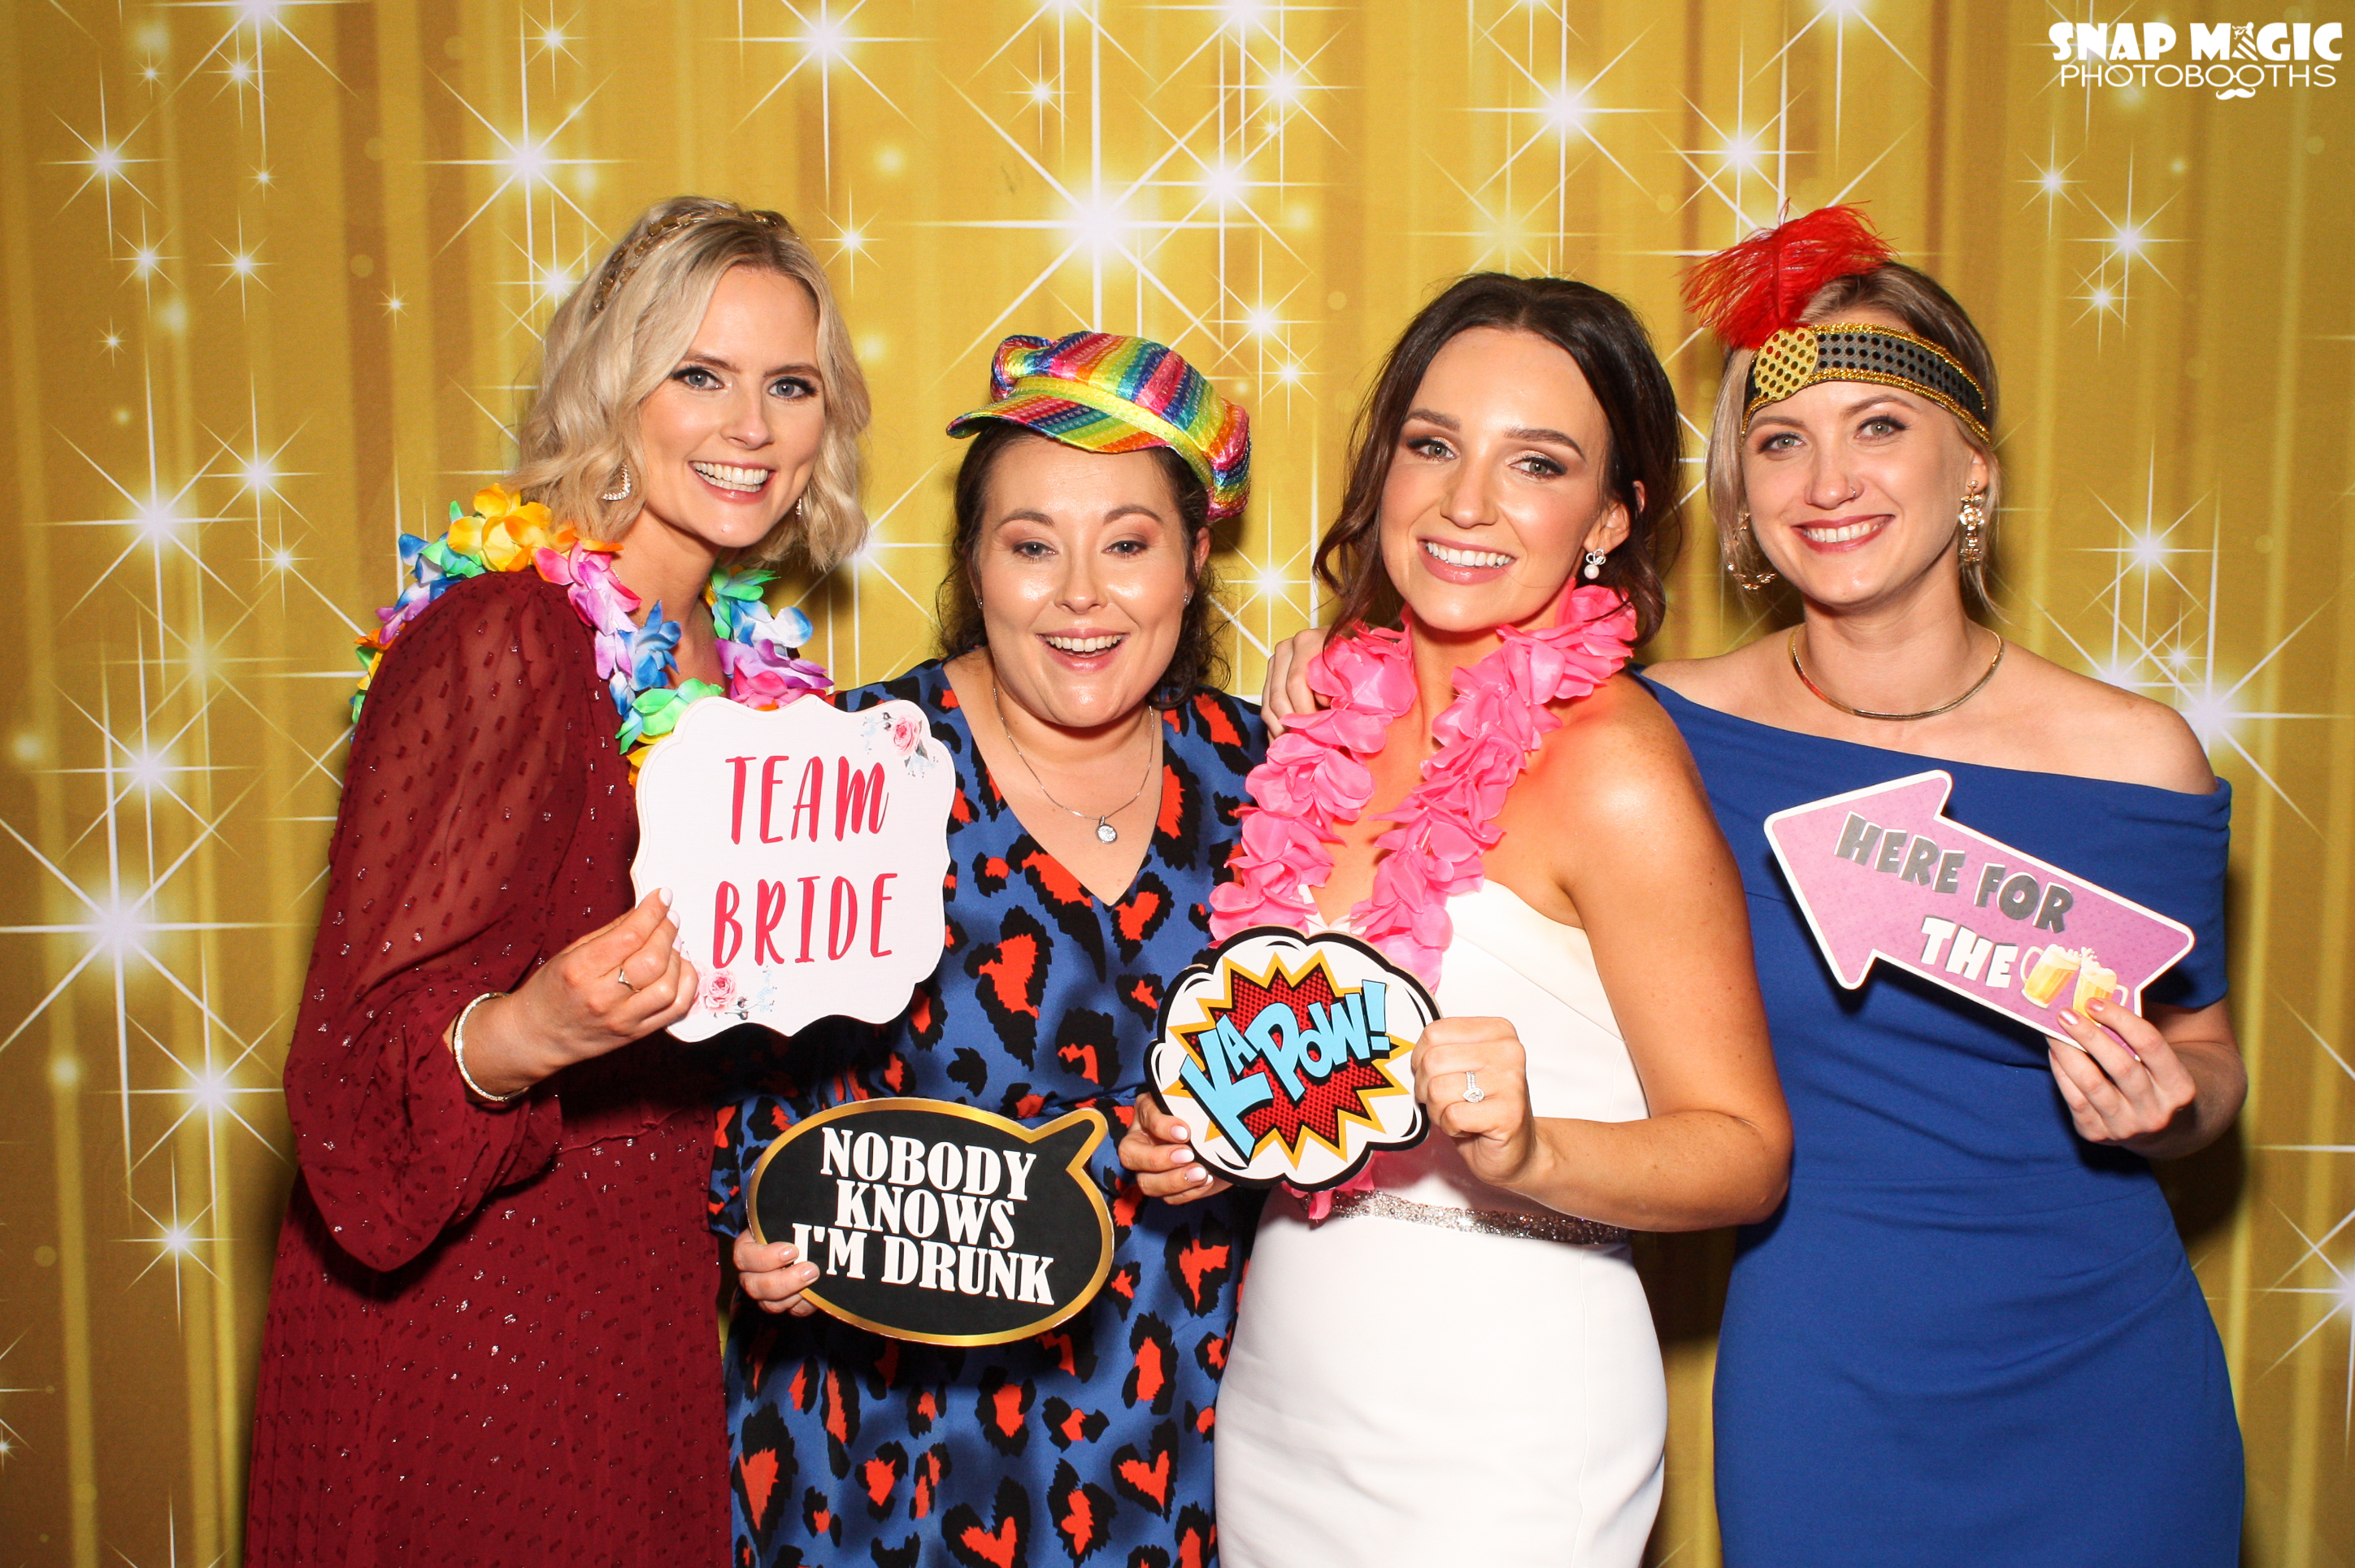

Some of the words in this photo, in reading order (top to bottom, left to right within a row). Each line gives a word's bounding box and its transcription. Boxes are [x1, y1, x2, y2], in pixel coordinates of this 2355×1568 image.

[725, 755, 889, 845] TEAM
[1834, 810, 1965, 895] HERE
[1974, 862, 2074, 934] FOR
[713, 873, 898, 969] BRIDE
[1921, 915, 2018, 988] THE
[1180, 979, 1391, 1165] KAPOW!
[819, 1127, 1037, 1201] NOBODY
[834, 1179, 1015, 1249] KNOWS
[792, 1223, 868, 1279] I'M
[880, 1235, 1055, 1305] DRUNK
